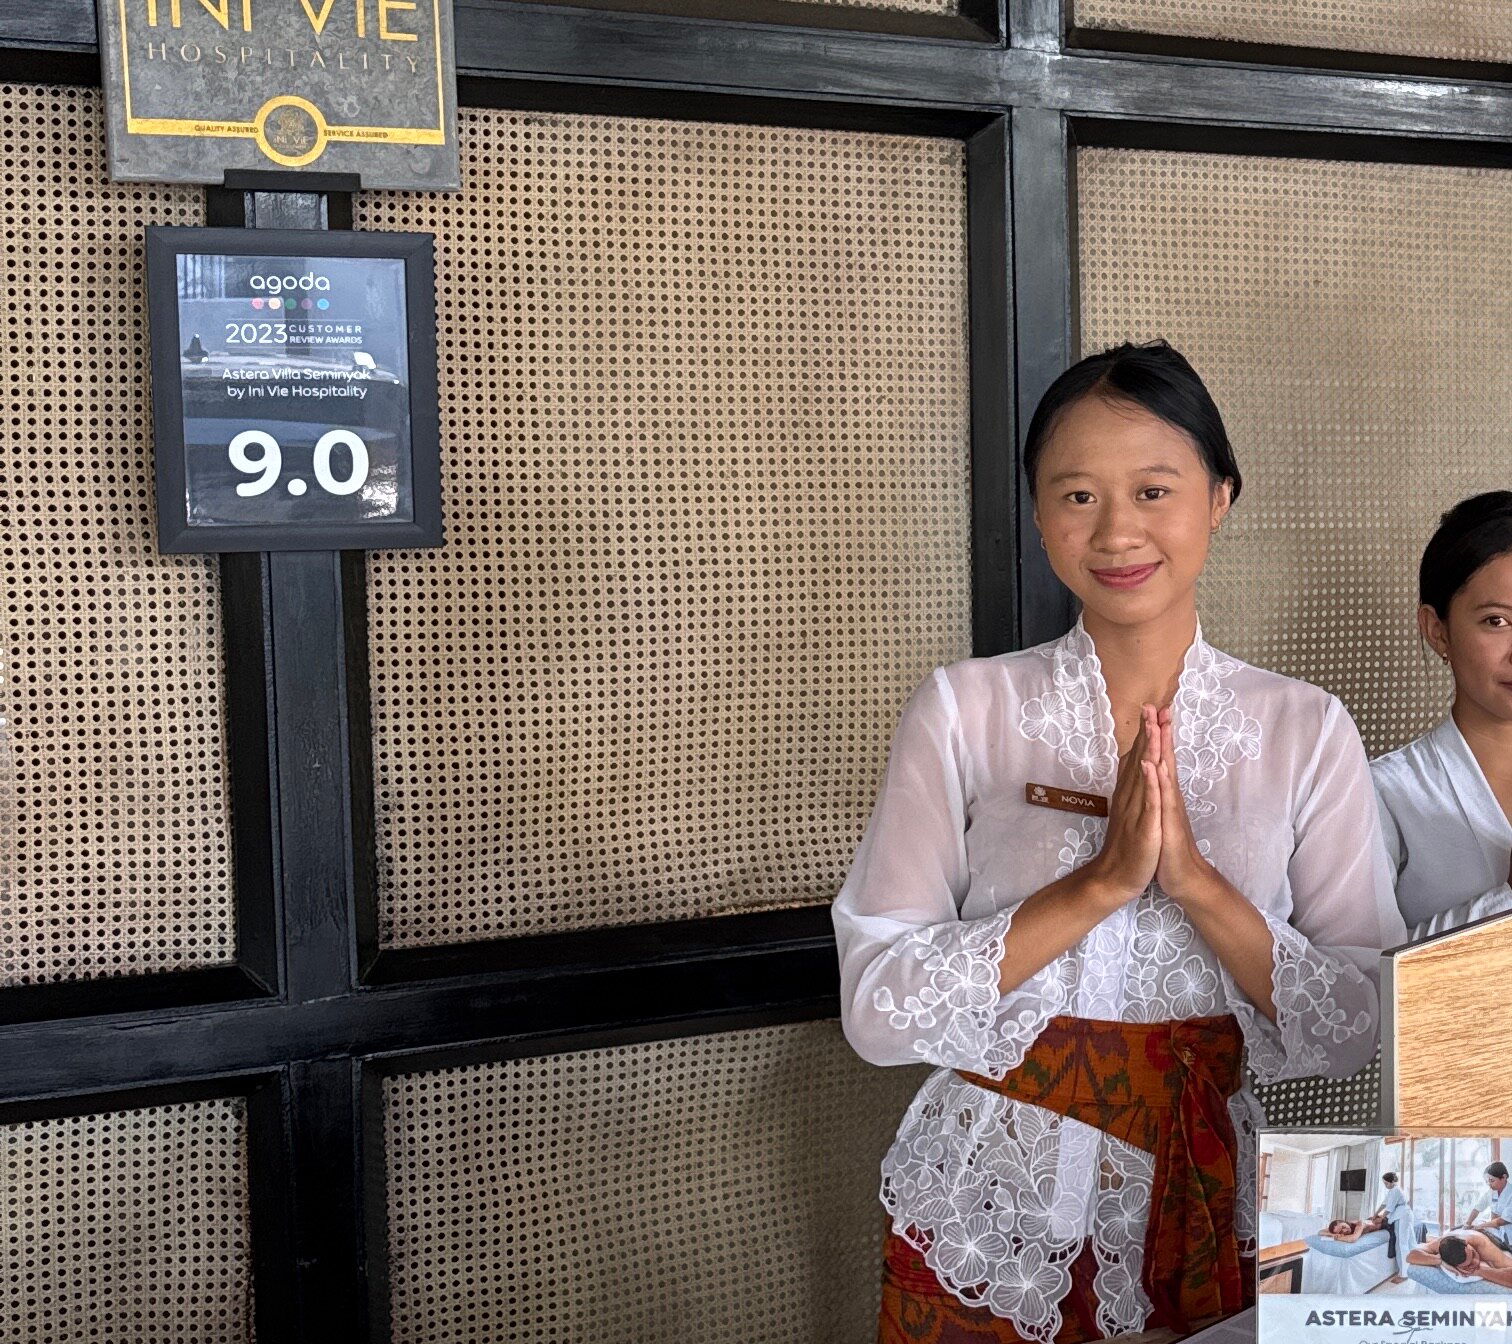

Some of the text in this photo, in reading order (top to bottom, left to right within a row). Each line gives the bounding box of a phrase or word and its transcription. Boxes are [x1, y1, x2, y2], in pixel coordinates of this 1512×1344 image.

[148, 42, 419, 73] HOSPITALITY
[194, 125, 225, 133] QUALITY
[250, 272, 331, 294] agoda
[225, 323, 362, 344] 2023 CUSTOMER
[289, 336, 363, 344] REVIEW AWARDS
[222, 368, 371, 383] Astera Villa Seminyak
[227, 385, 368, 400] by Ini Vie Hospitality
[228, 429, 370, 497] 9.0
[1061, 795, 1096, 807] NOVIA
[1305, 1310, 1395, 1327] ASTERA
